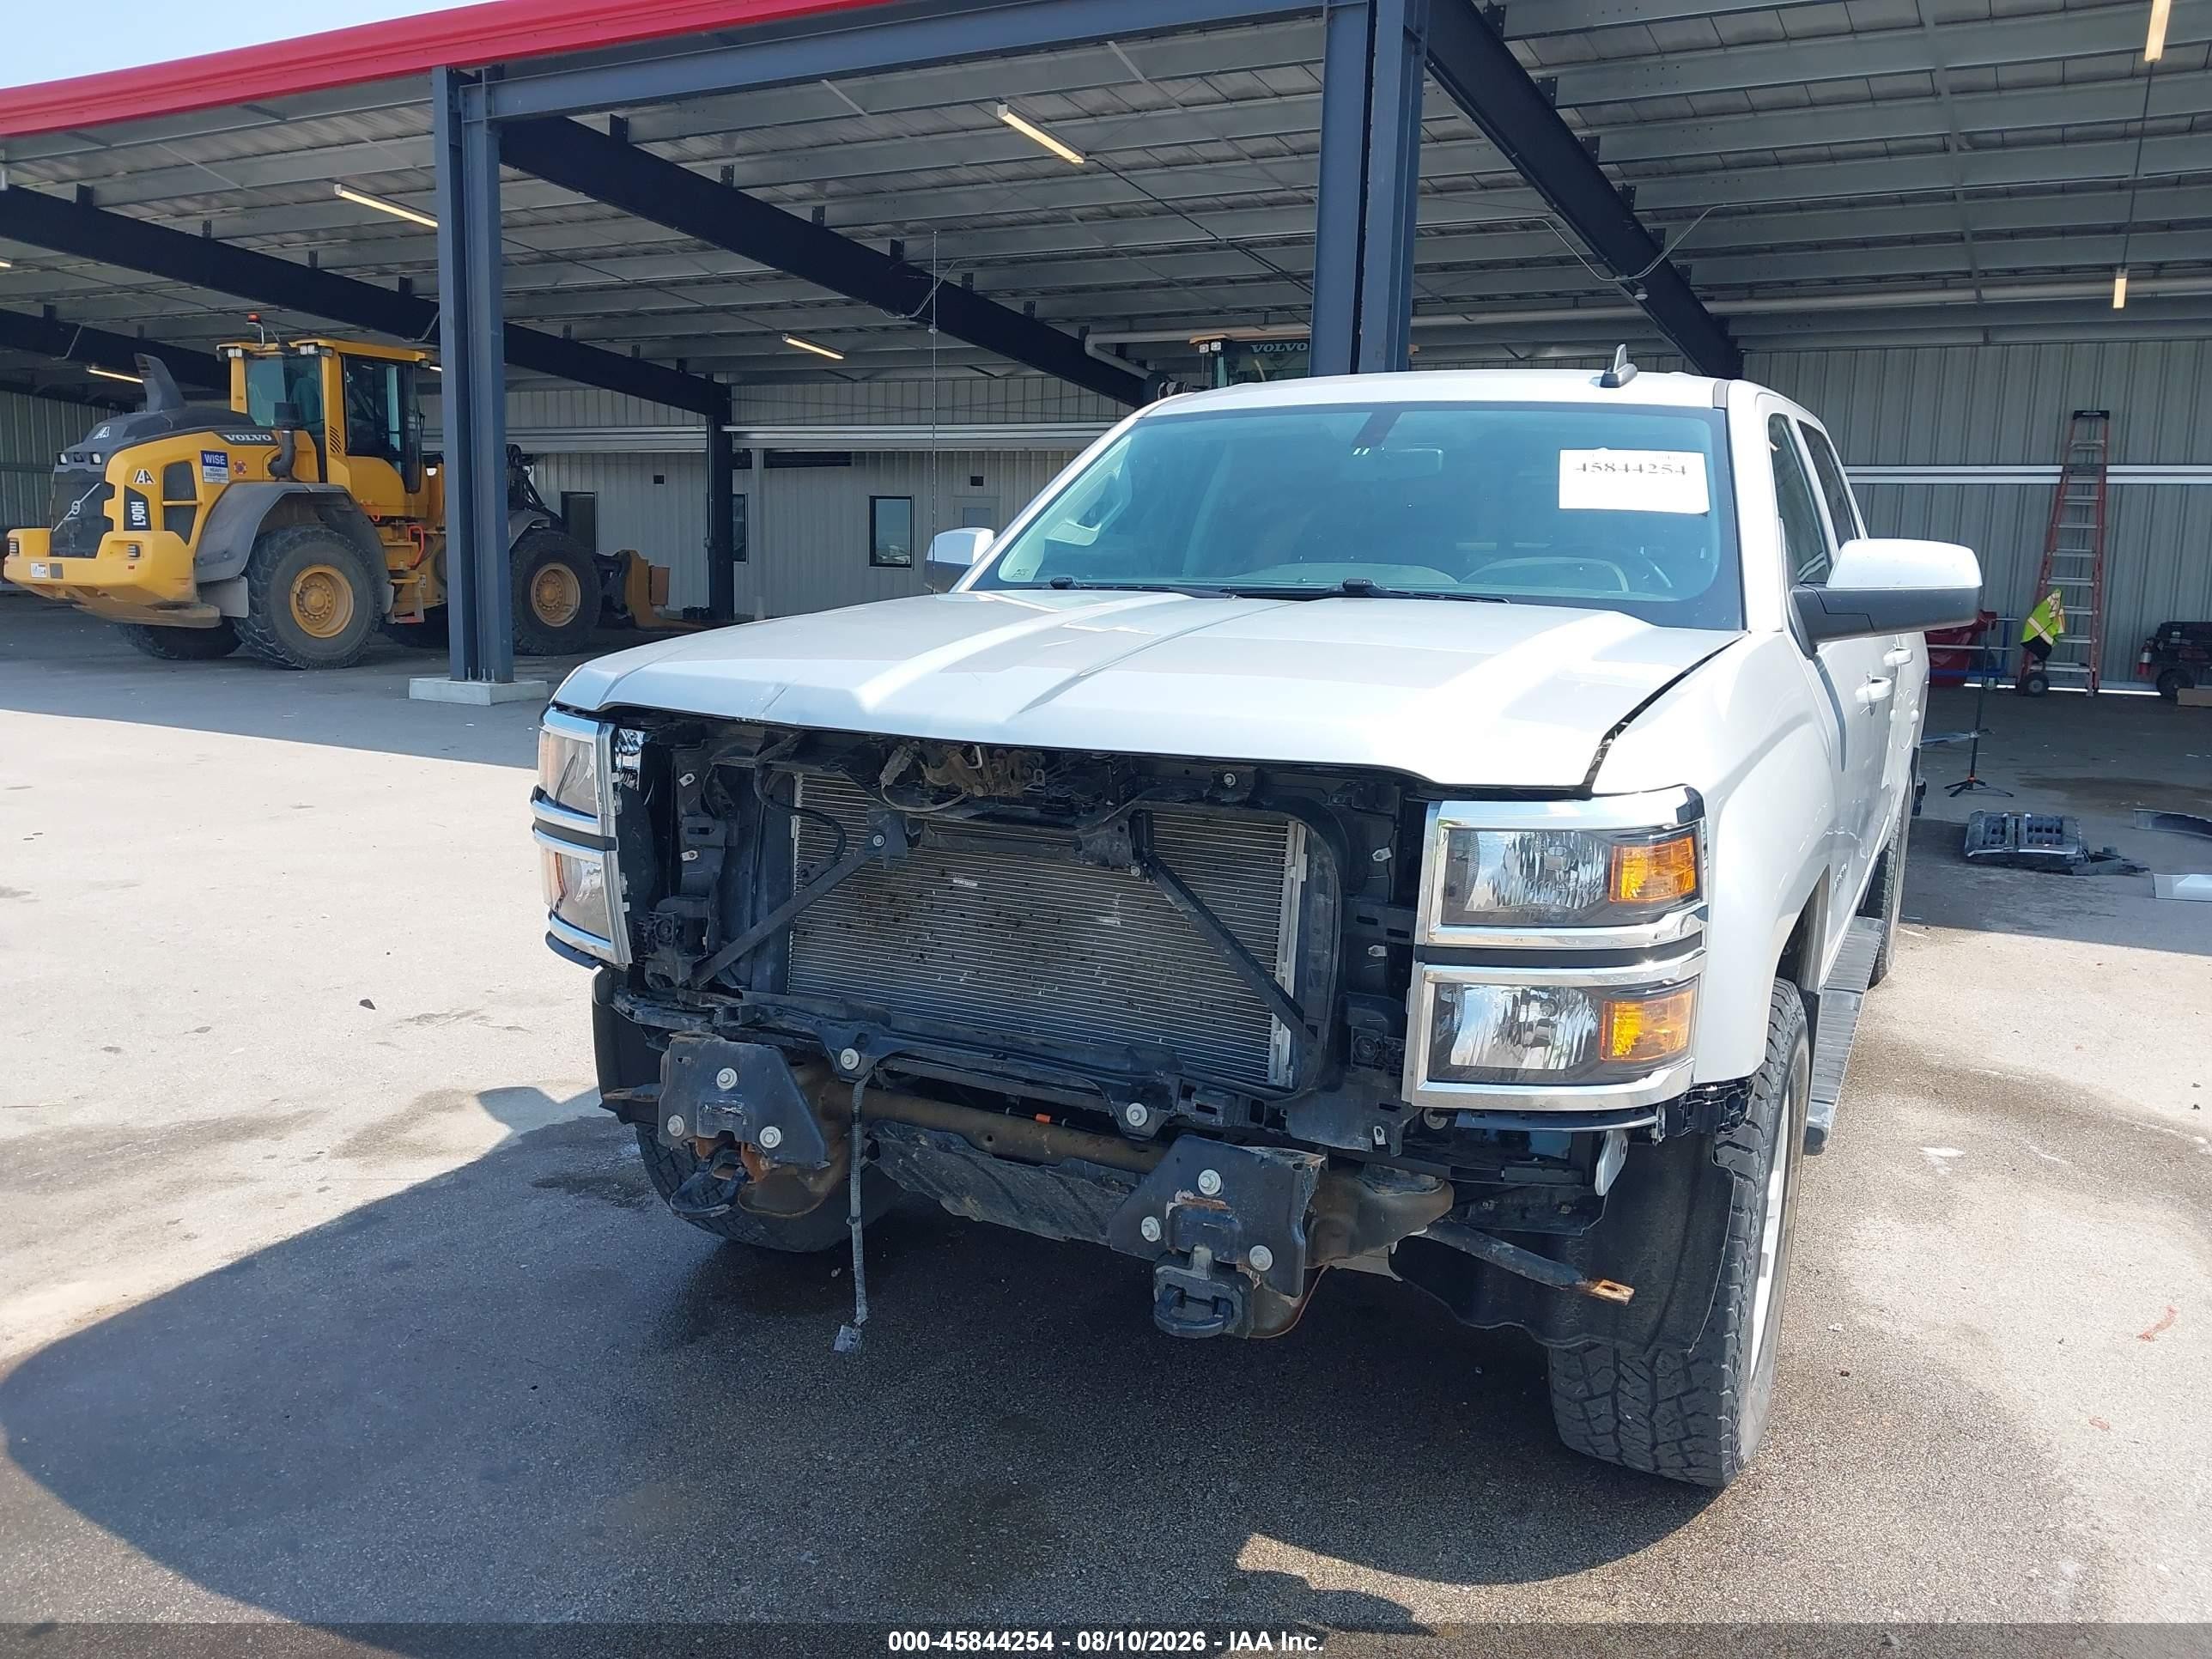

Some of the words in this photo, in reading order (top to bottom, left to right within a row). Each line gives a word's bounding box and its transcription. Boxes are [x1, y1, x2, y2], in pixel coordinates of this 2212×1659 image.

[1250, 342, 1308, 353] VOLVO
[204, 453, 226, 465] WISE
[1575, 462, 1686, 475] 45844254
[130, 501, 147, 526] L90H
